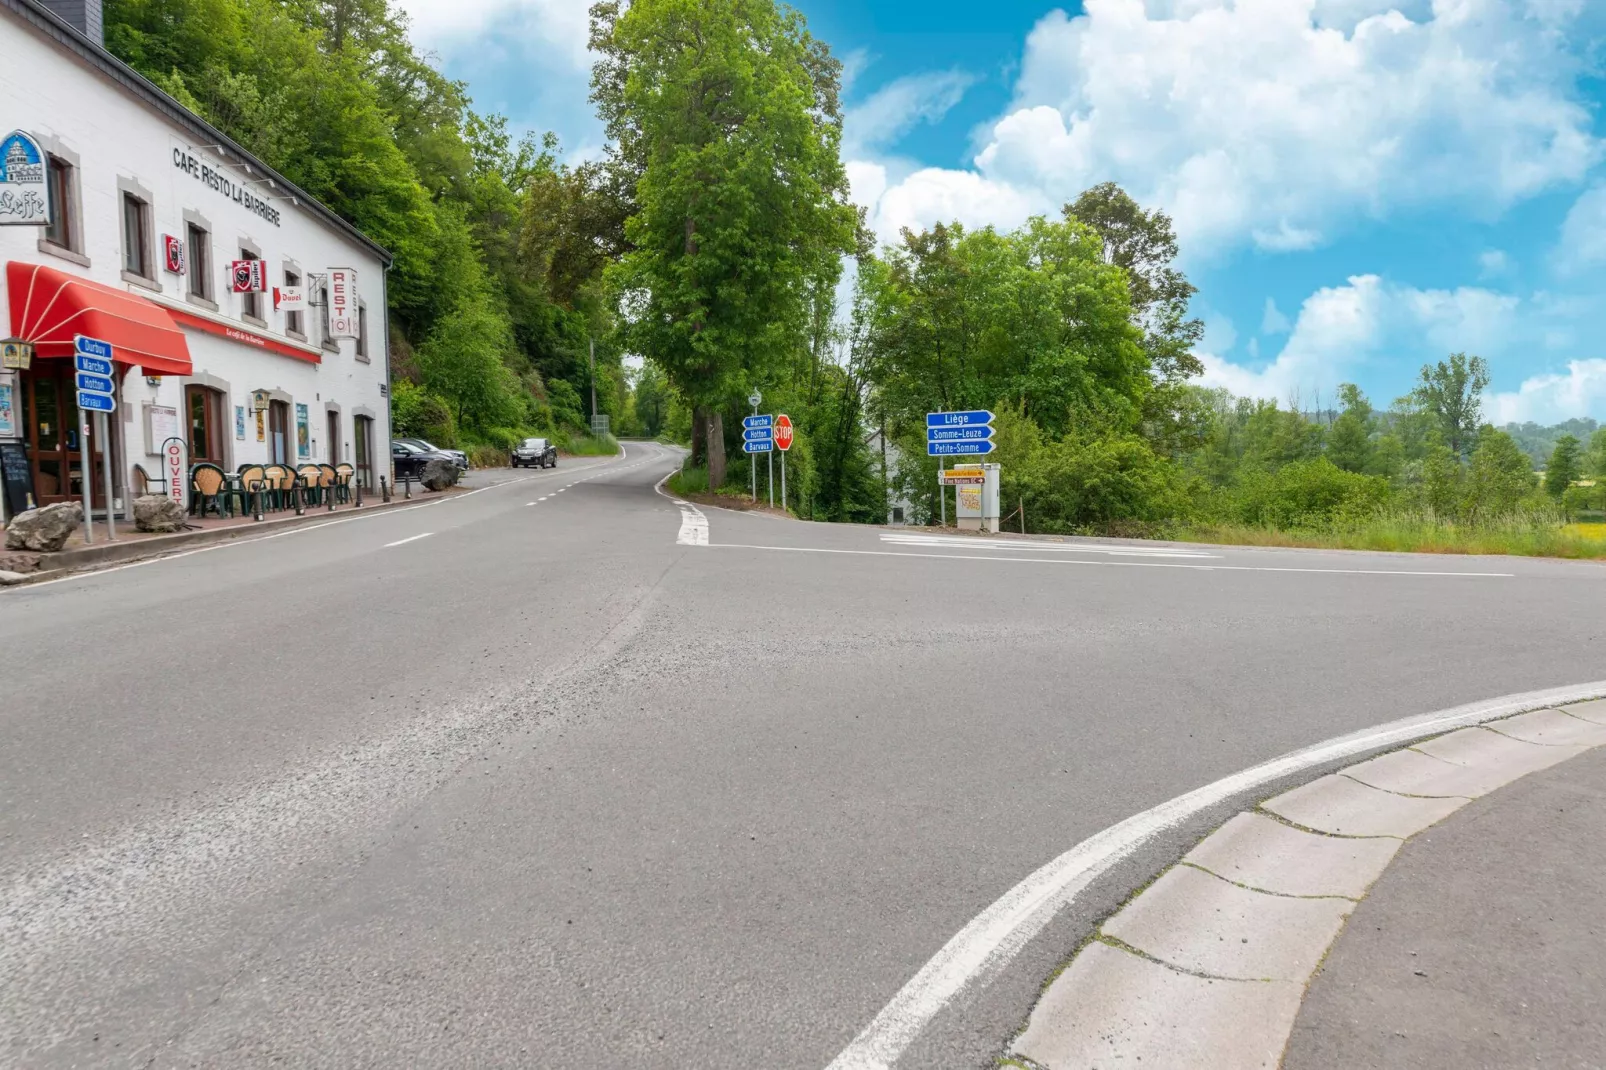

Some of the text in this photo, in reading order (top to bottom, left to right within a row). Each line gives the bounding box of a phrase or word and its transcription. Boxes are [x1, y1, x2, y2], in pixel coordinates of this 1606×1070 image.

[173, 147, 281, 228] CAFE RESTO LA BARRIERE
[0, 189, 44, 219] Leffe
[252, 261, 260, 288] Jupiler
[84, 339, 106, 357] Durbuy
[82, 358, 105, 373] Marche
[84, 376, 105, 390] Hotton
[81, 394, 102, 408] Barvaux
[750, 417, 768, 427] Marche
[944, 413, 969, 426] Liège
[750, 430, 767, 439] Hotton
[775, 426, 792, 440] STOP
[933, 428, 982, 439] Somme-Leuze
[749, 442, 770, 451] Barvaux
[935, 442, 980, 453] Petite-Somme
